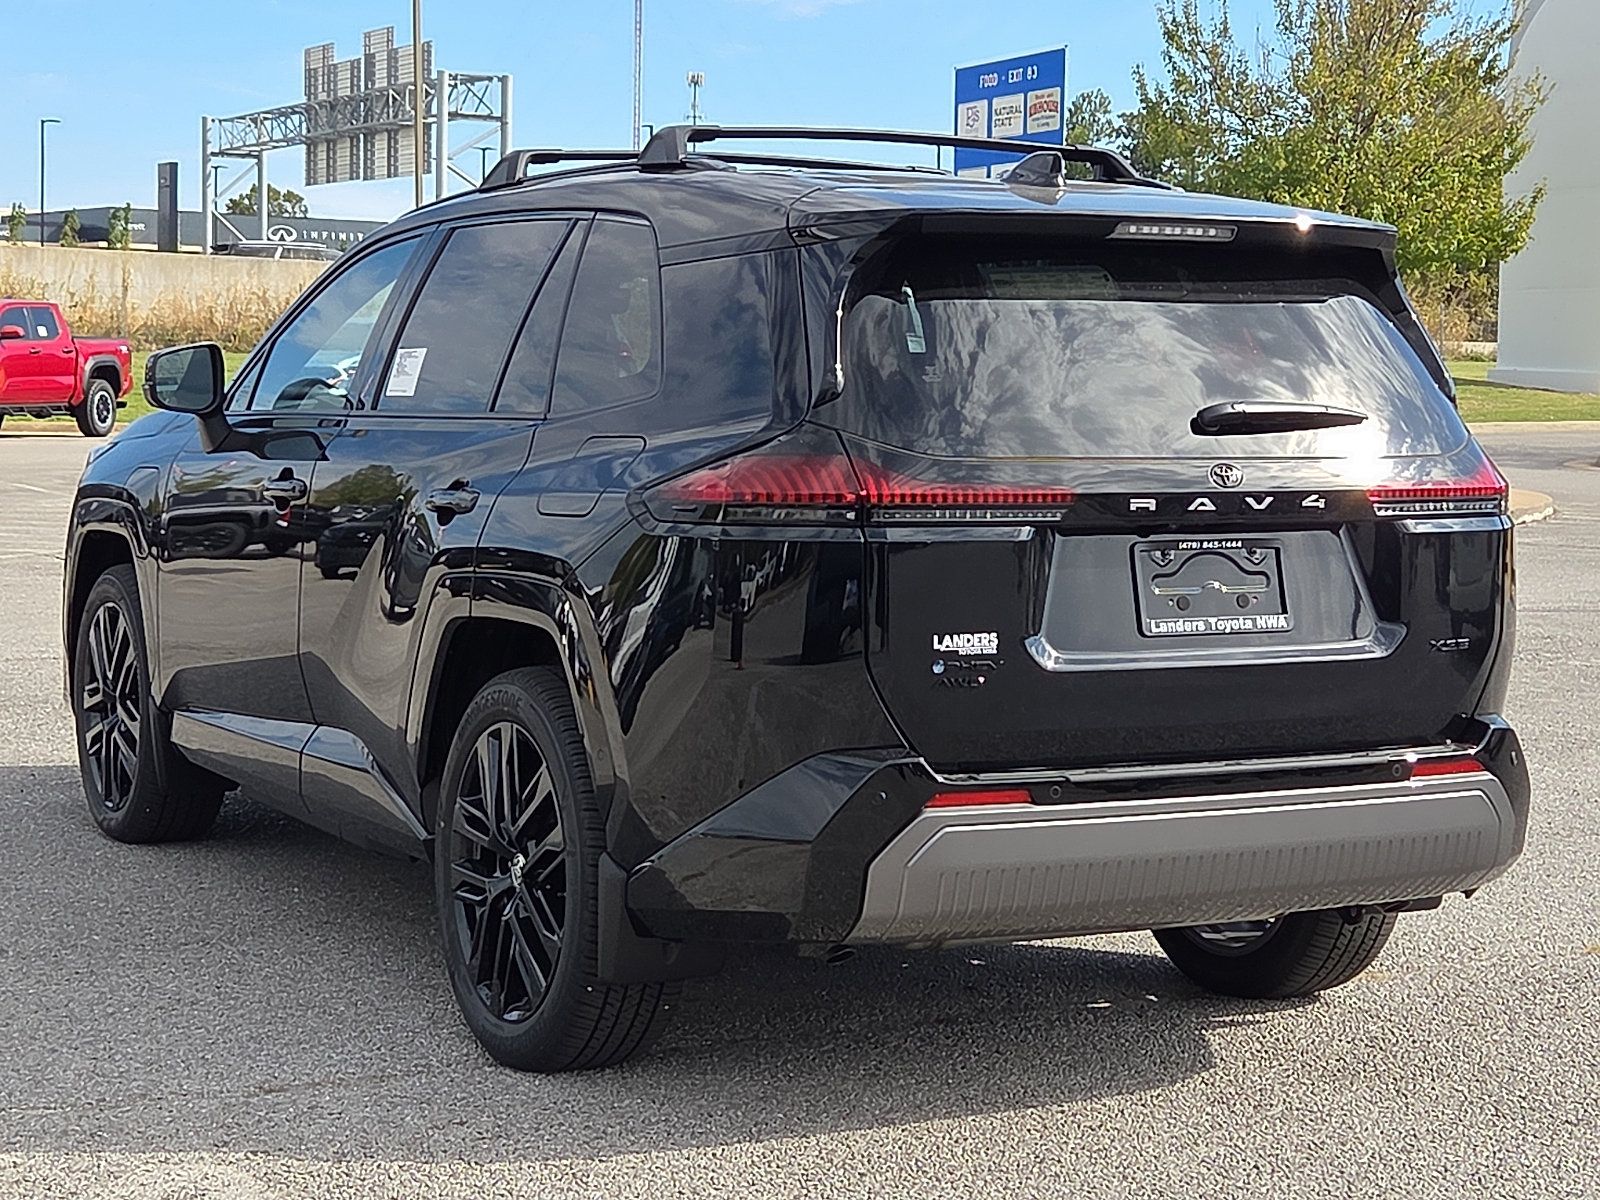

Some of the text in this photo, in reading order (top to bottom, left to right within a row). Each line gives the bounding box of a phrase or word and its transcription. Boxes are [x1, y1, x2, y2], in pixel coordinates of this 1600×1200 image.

[979, 72, 999, 89] FOOD
[1008, 67, 1024, 84] EXIT
[994, 104, 1022, 117] NATURAL
[993, 116, 1013, 128] STATE
[1129, 494, 1326, 512] RAV4
[1150, 615, 1288, 633] Landers Toyota NWA
[933, 632, 999, 650] LANDERS
